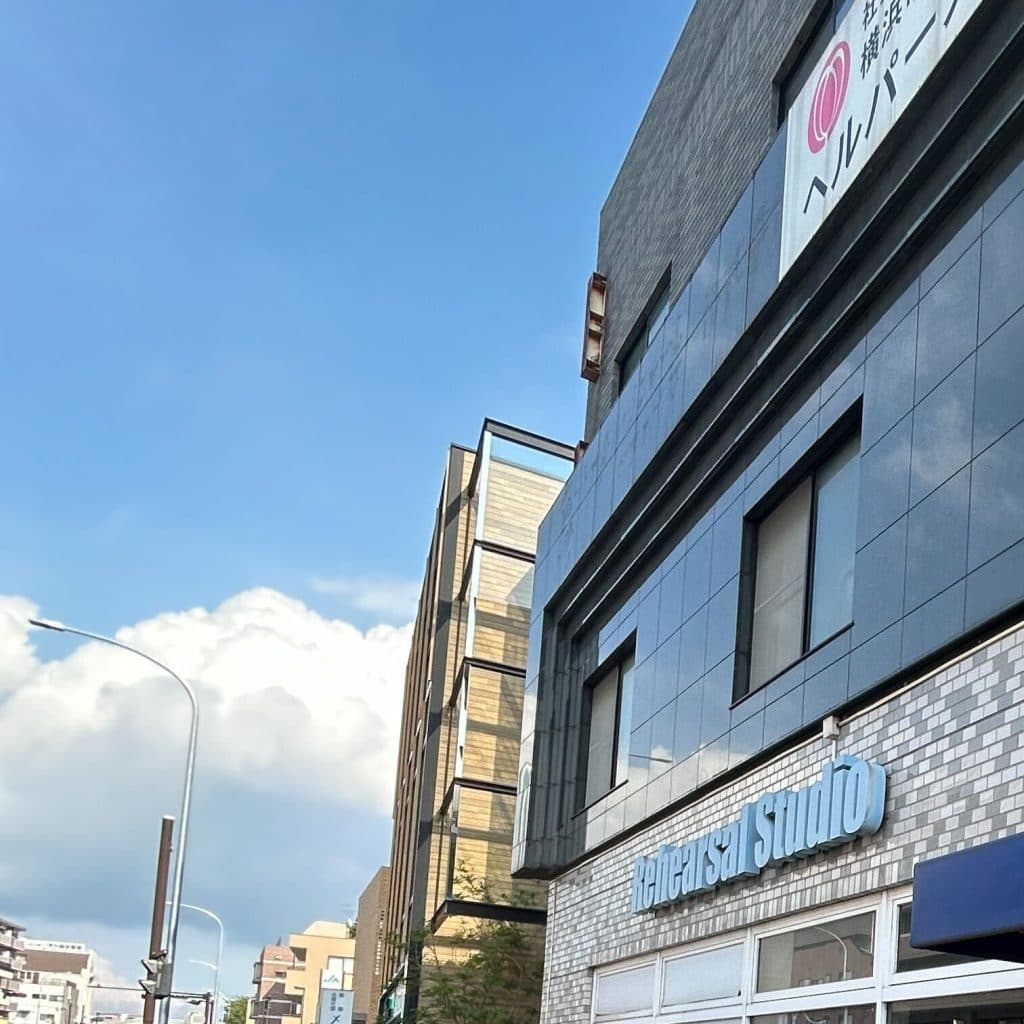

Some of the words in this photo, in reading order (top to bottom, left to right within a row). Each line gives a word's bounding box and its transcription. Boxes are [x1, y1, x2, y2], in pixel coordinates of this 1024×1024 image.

[803, 0, 958, 214] ヘルパー
[861, 0, 910, 80] 横浜
[631, 803, 758, 914] Rehearsal
[753, 754, 885, 869] Studio
